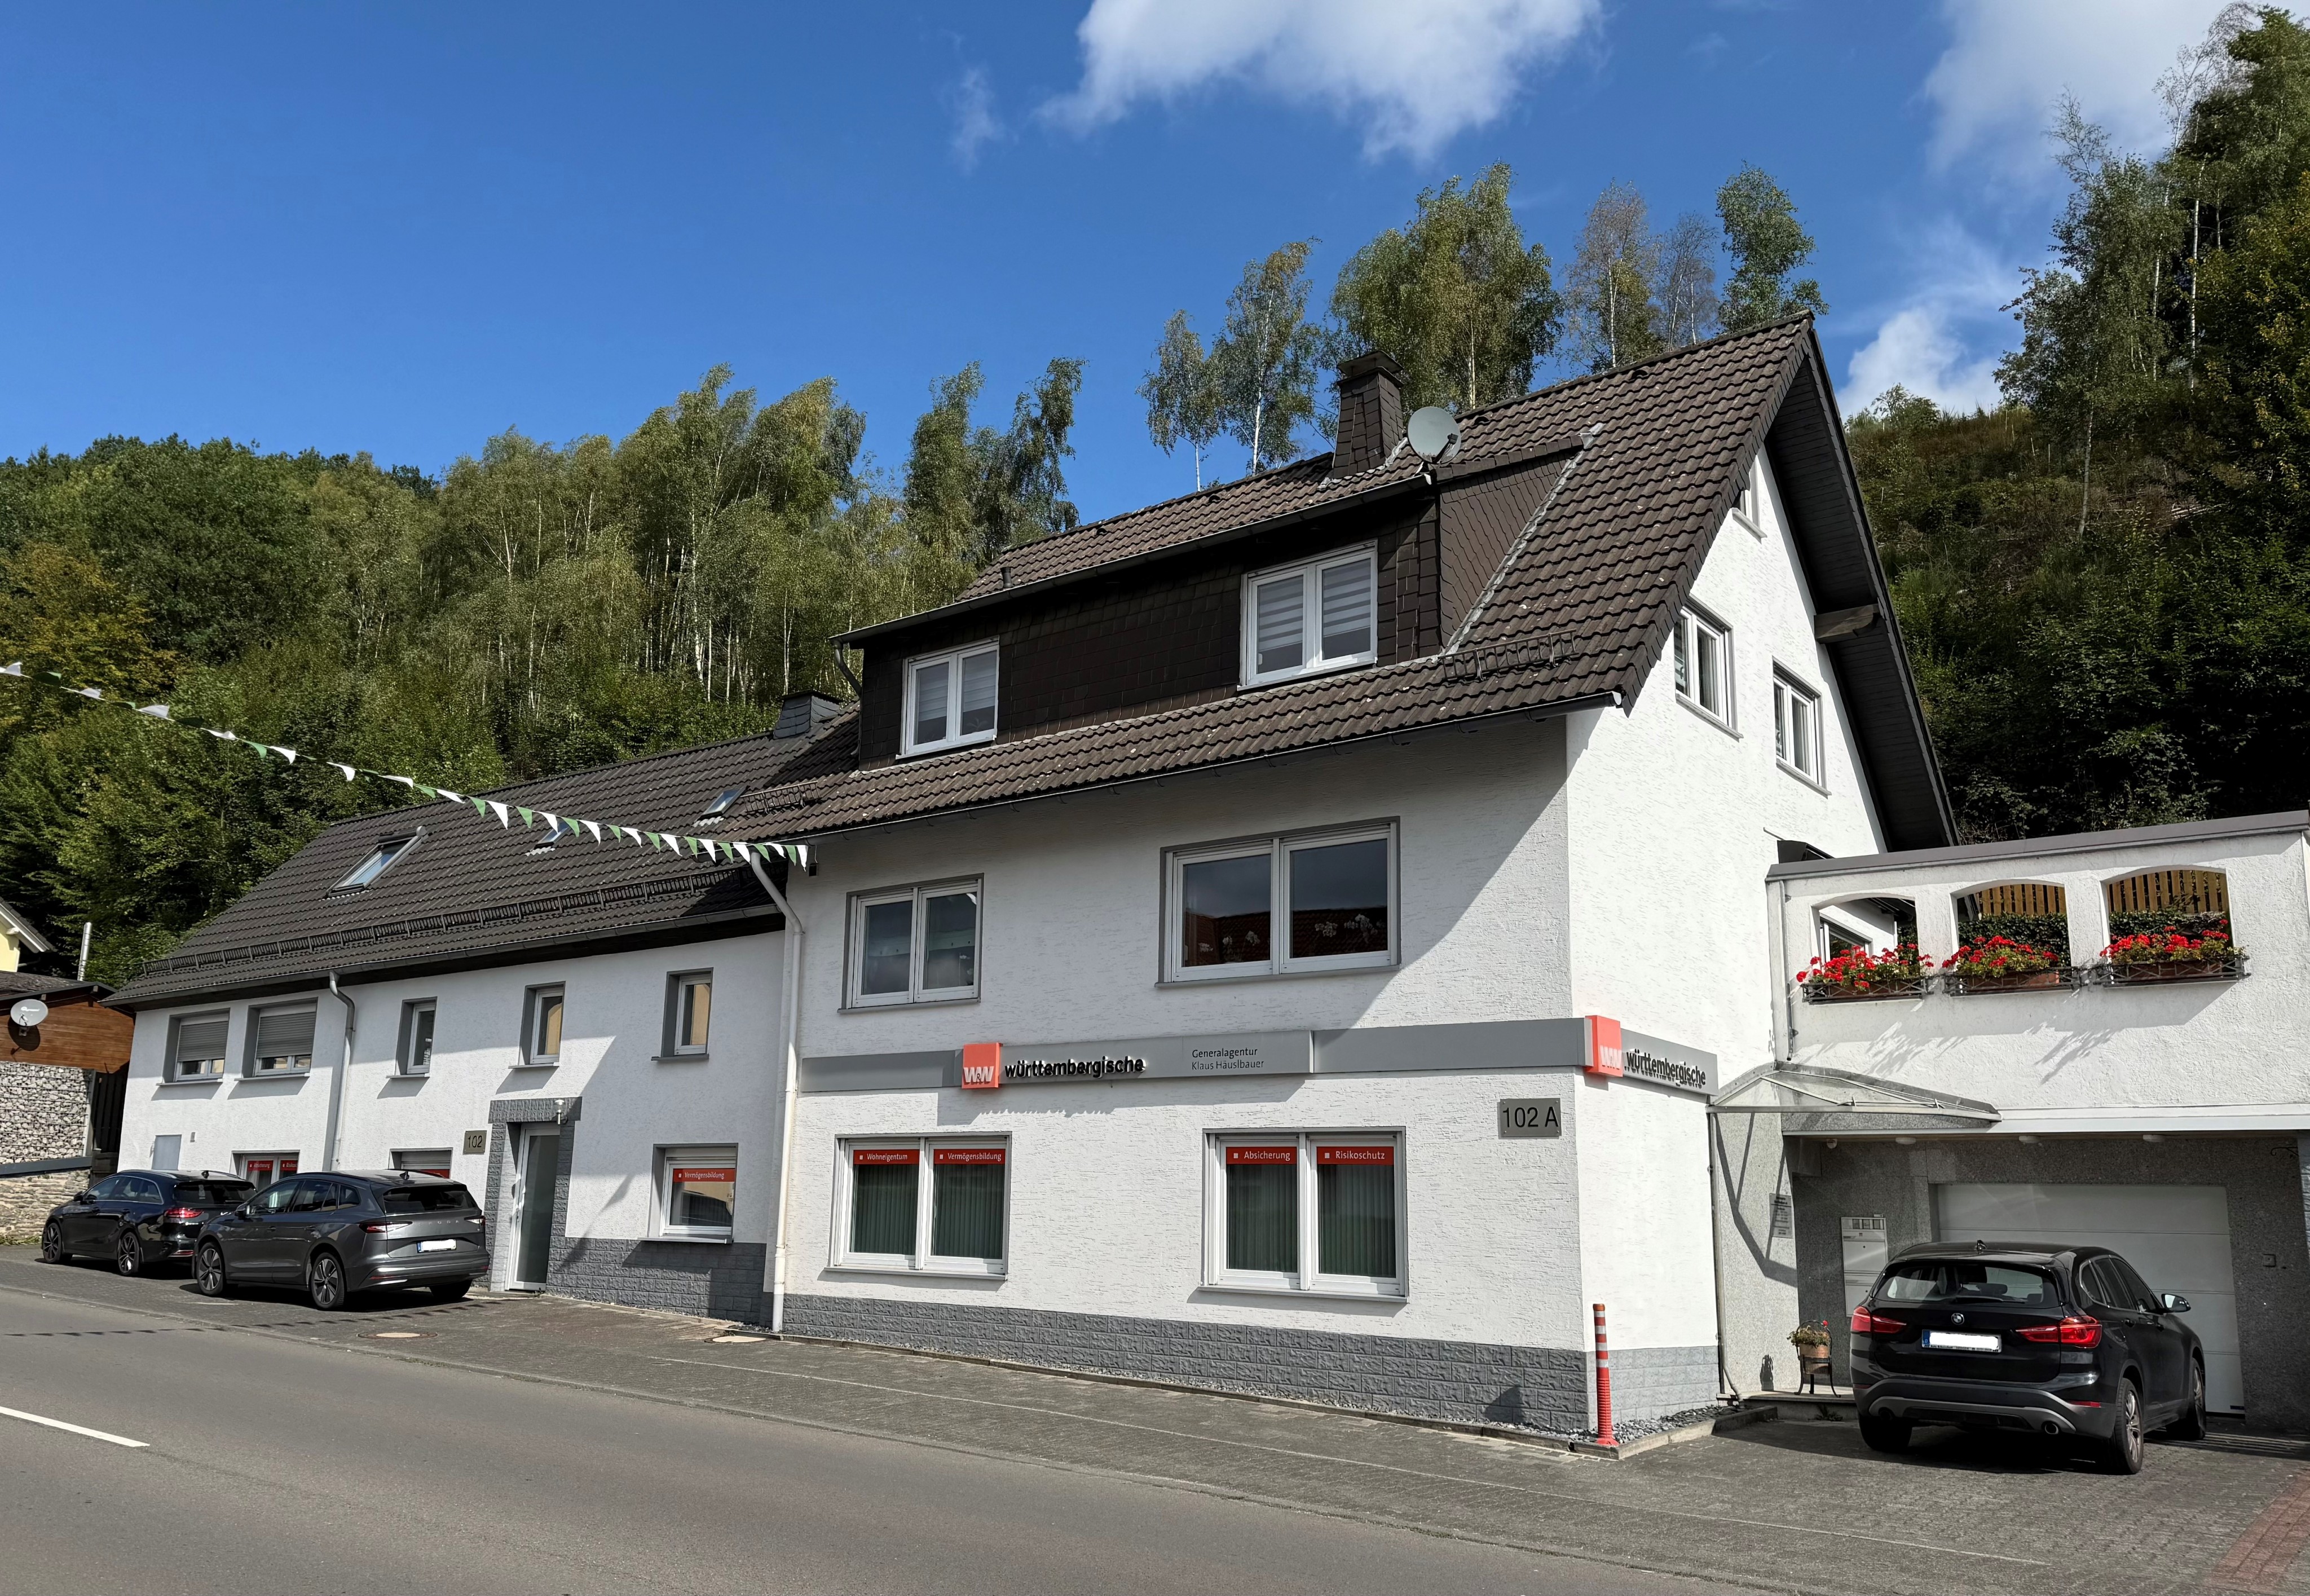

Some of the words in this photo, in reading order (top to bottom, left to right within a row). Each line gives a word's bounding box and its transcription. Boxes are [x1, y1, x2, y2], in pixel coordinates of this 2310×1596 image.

[1192, 1048, 1258, 1059] Generalagentur
[1004, 1056, 1146, 1078] württembergische
[1192, 1061, 1214, 1070] Klaus
[1216, 1060, 1264, 1069] Häuslbauer
[1626, 1048, 1706, 1086] württembergische
[963, 1066, 994, 1084] W&W
[1502, 1107, 1538, 1127] 102
[1544, 1106, 1559, 1127] A
[468, 1135, 483, 1148] 102
[867, 1153, 907, 1162] Wohneigentum
[947, 1153, 1002, 1162] Vermögensbildung
[1244, 1151, 1290, 1161] Absicherung
[1335, 1151, 1385, 1159] Risikoschutz
